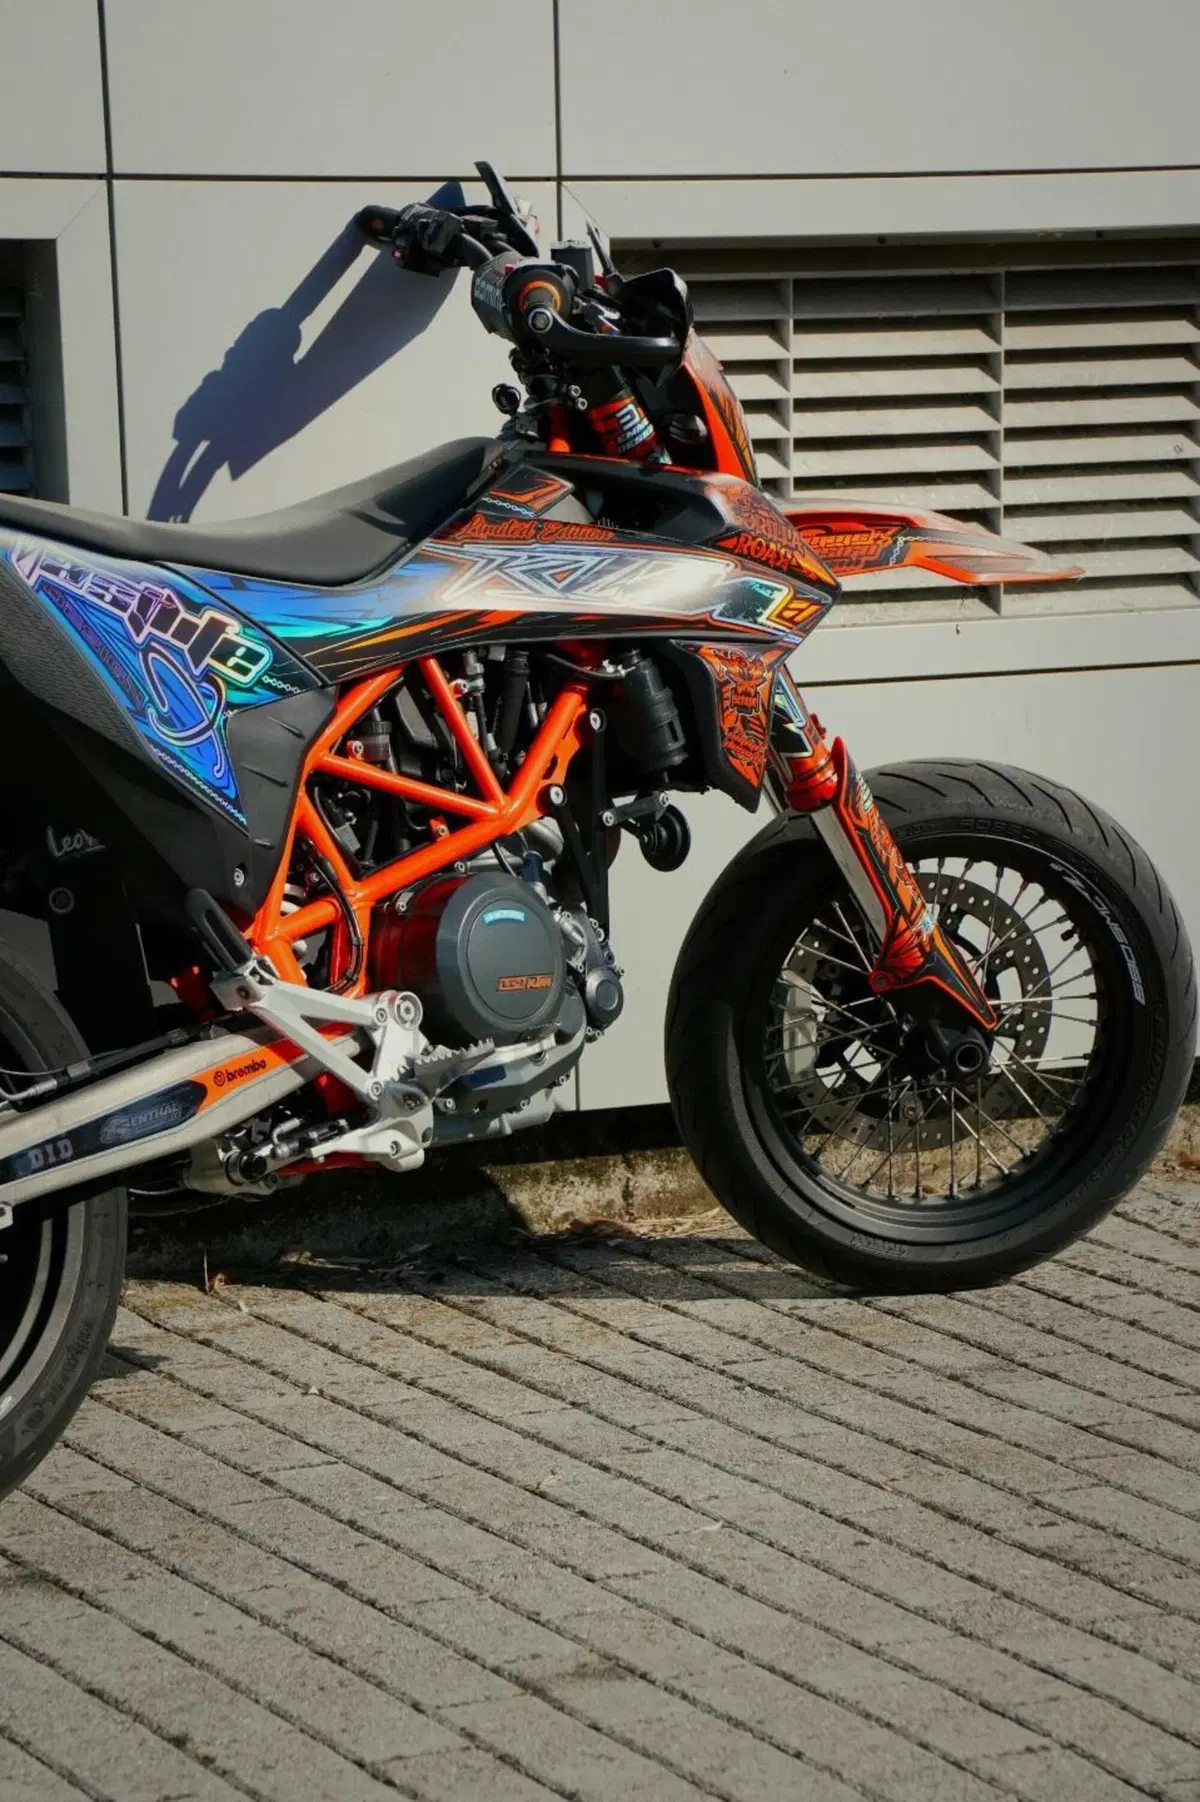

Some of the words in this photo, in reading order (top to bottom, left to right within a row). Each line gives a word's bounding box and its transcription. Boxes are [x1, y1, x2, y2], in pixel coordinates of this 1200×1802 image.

[537, 519, 615, 543] Edition
[224, 1058, 267, 1083] brembo
[31, 1138, 74, 1164] DID
